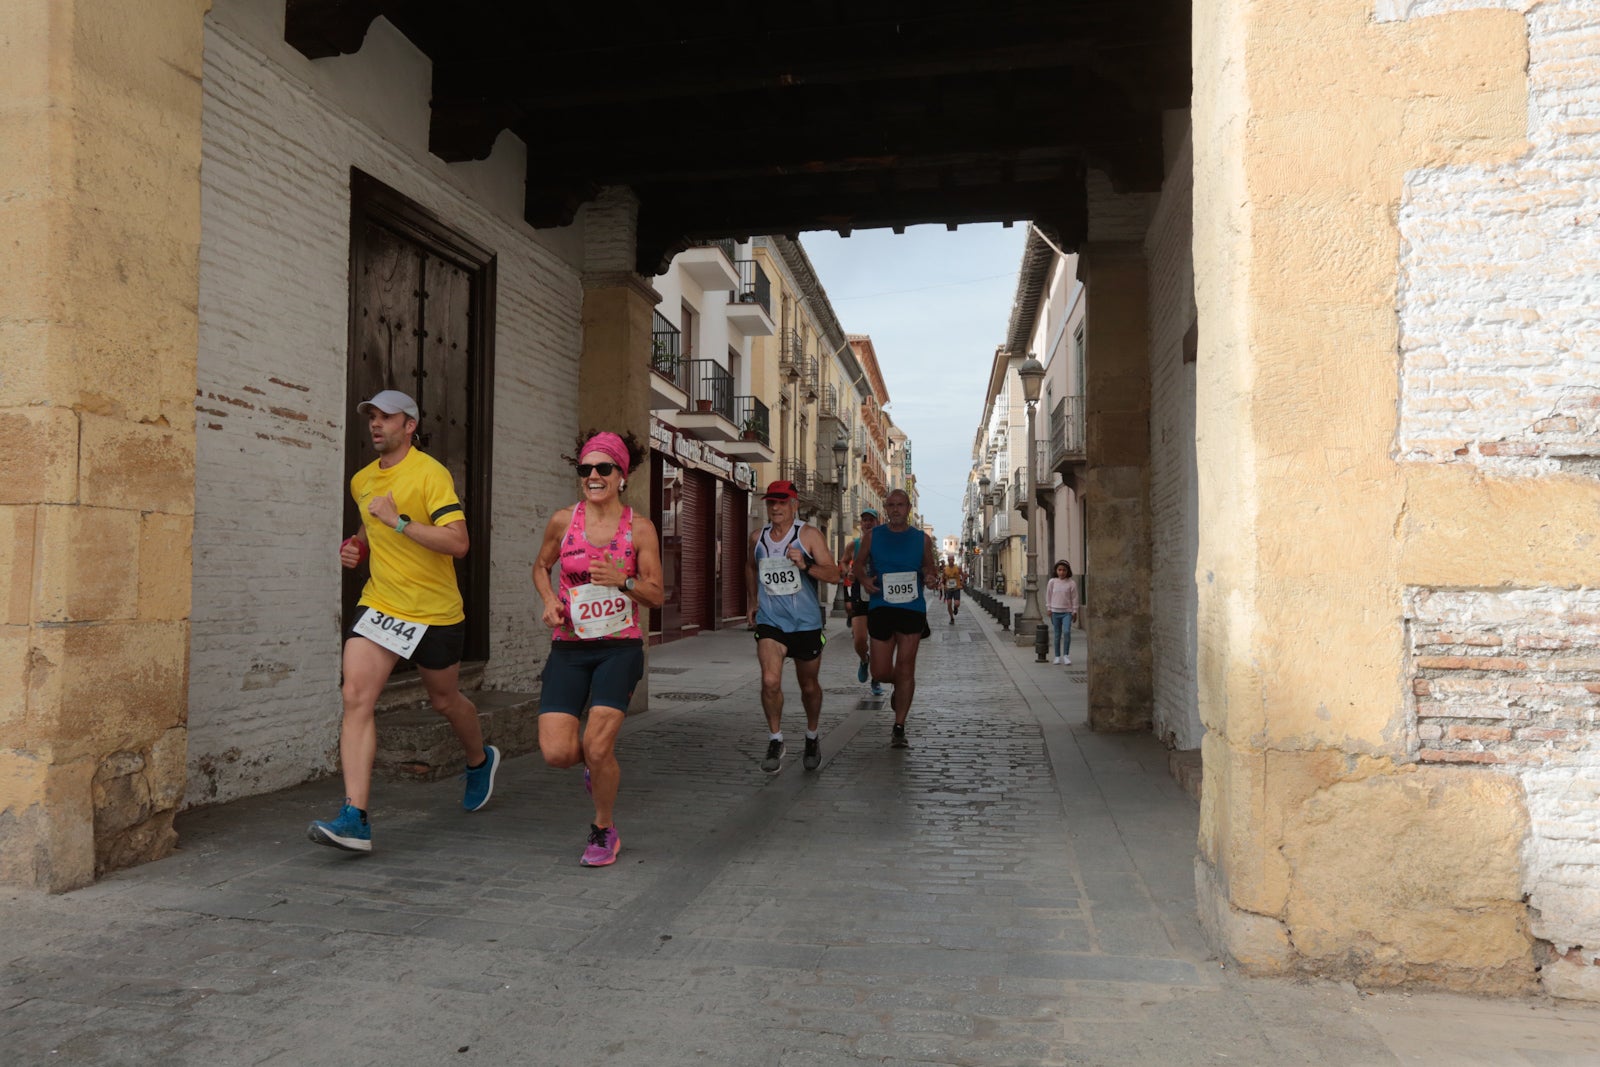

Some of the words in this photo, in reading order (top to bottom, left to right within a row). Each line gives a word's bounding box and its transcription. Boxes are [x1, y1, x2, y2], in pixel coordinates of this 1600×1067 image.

[764, 570, 795, 585] 3083
[887, 583, 914, 595] 3095
[579, 598, 626, 620] 2029
[370, 610, 417, 641] 3044
